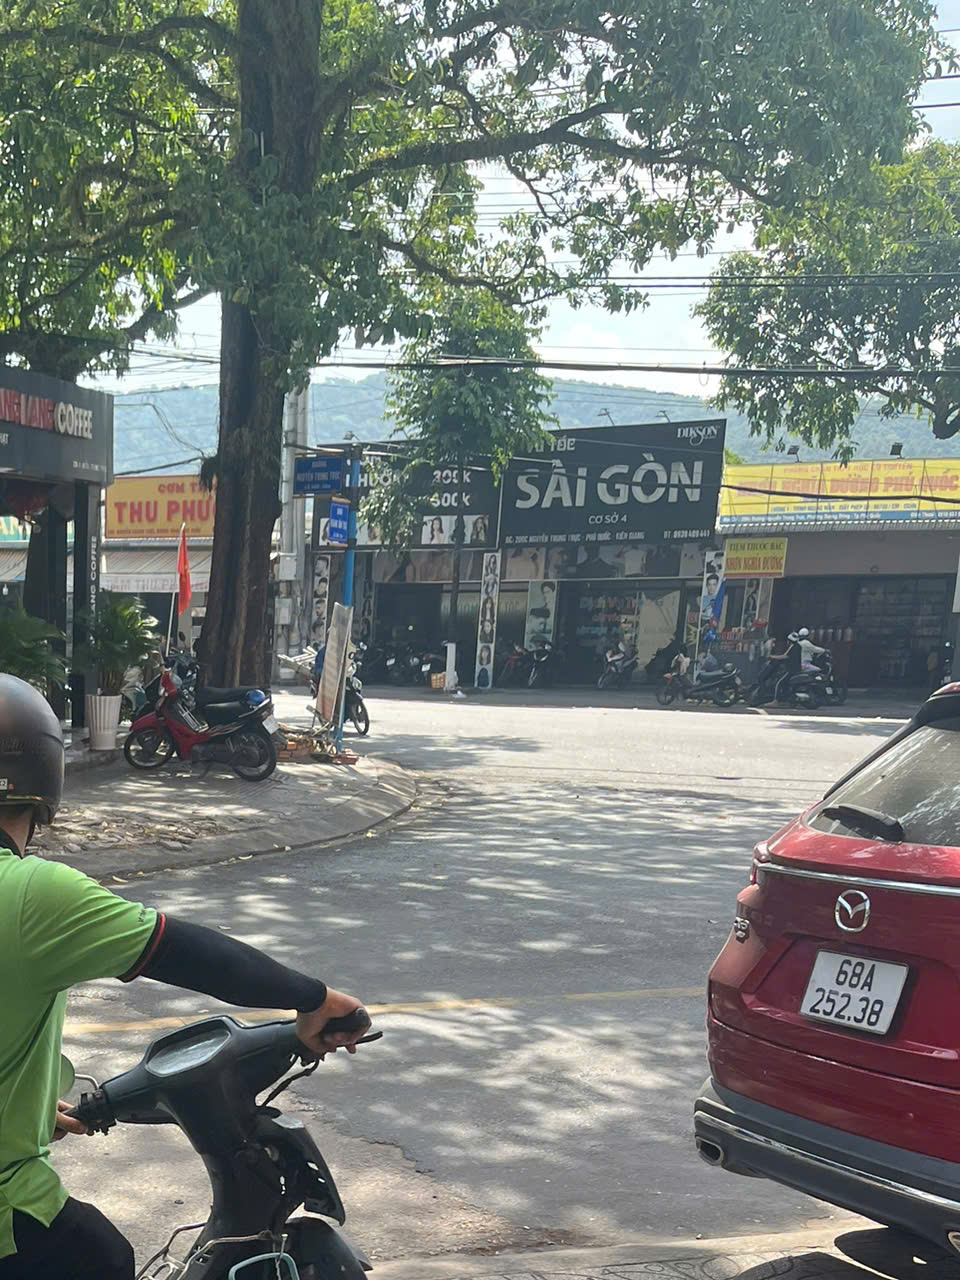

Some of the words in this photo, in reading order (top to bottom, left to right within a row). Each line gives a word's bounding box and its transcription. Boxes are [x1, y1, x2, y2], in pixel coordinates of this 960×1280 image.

[54, 401, 93, 439] COFFEE
[515, 458, 587, 508] SÀI
[597, 453, 704, 505] GÒN
[114, 501, 158, 524] THU
[620, 514, 628, 523] 4
[835, 959, 876, 992] 68A
[809, 987, 884, 1026] 252.38
